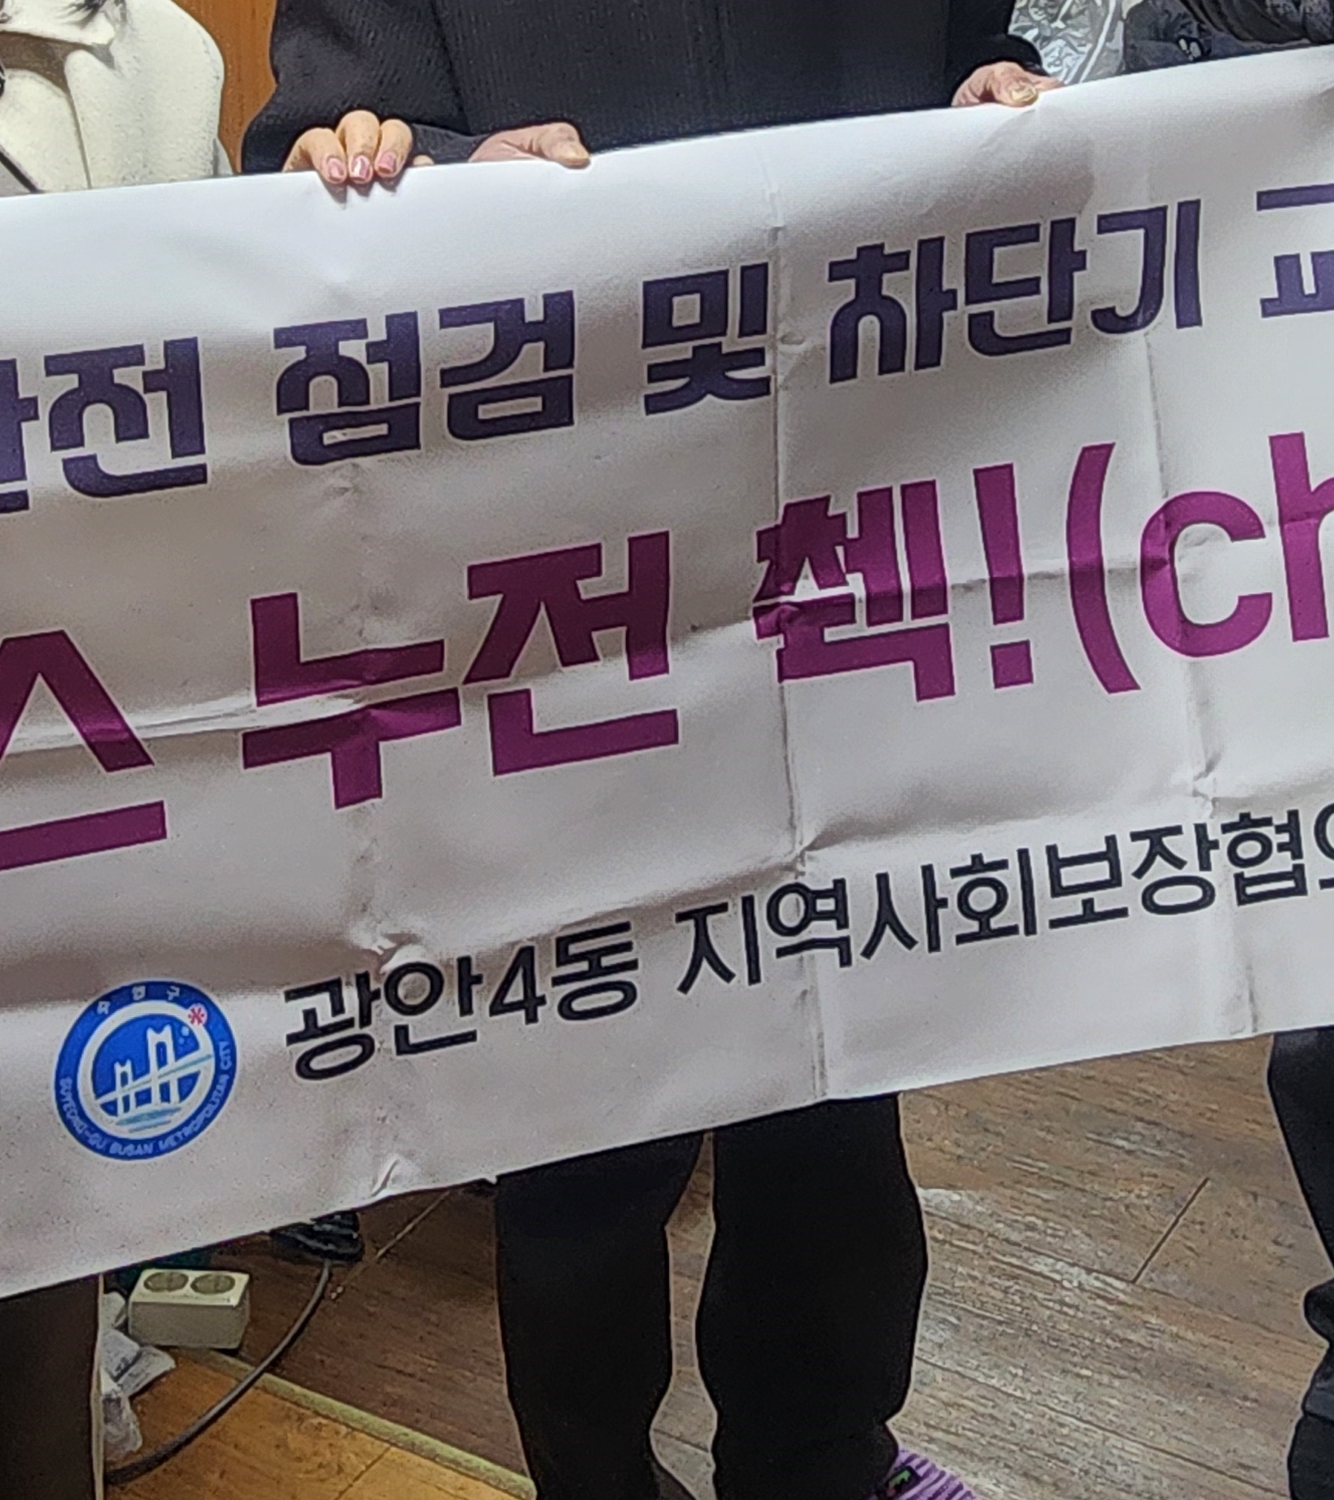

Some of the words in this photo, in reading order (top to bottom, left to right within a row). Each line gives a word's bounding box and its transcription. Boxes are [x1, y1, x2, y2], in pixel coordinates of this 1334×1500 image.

[273, 290, 576, 467] 점검
[642, 261, 773, 416] 및
[827, 198, 1202, 387] 차단기
[242, 529, 680, 810] 누전
[109, 1142, 154, 1157] BUSAN
[218, 1040, 233, 1071] CITY
[282, 919, 641, 1082] 광안4동
